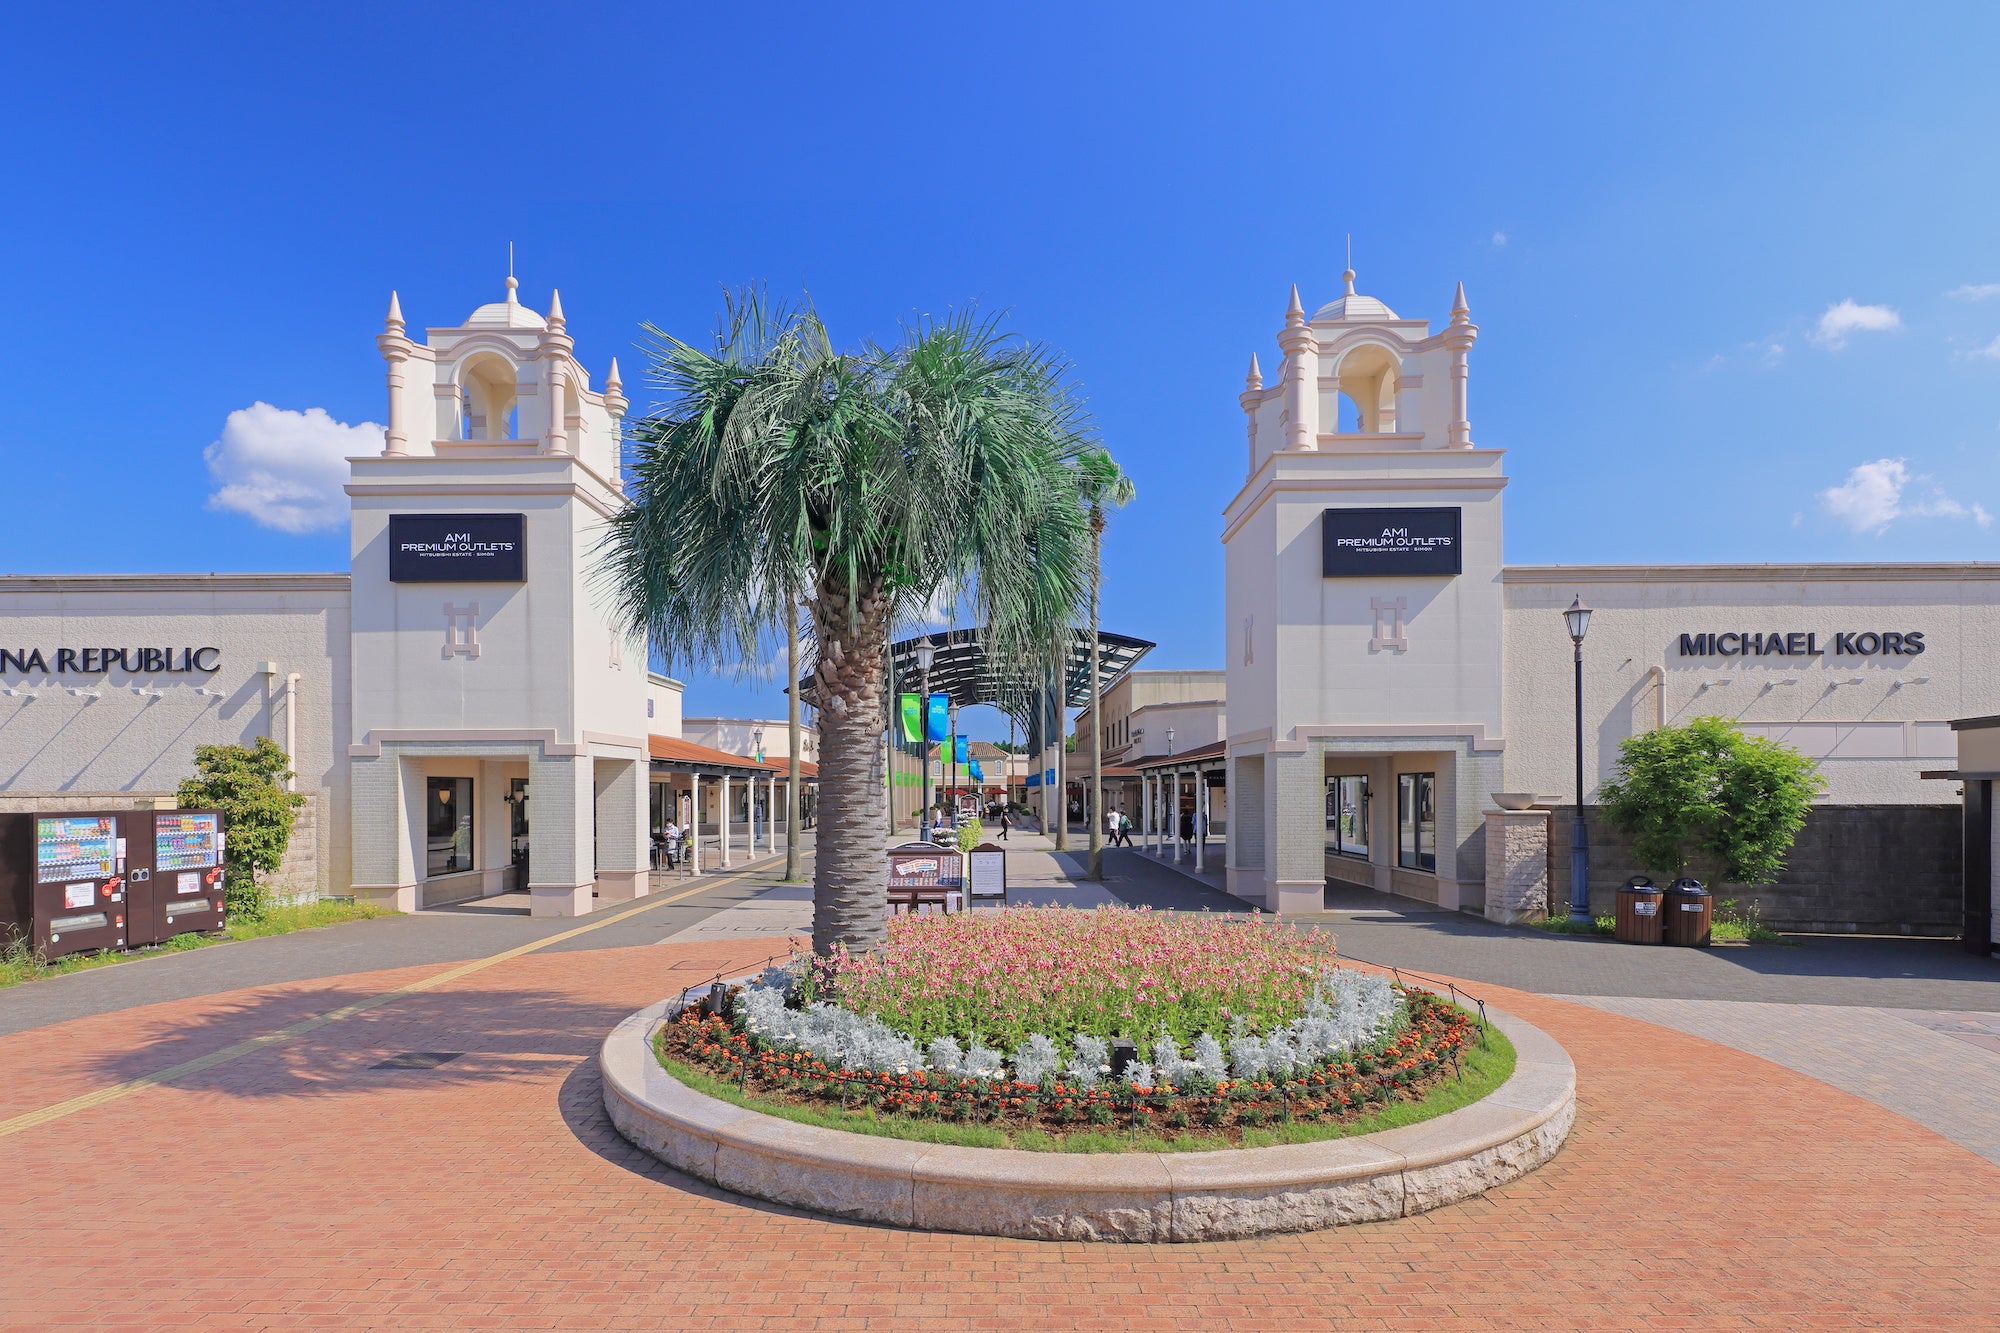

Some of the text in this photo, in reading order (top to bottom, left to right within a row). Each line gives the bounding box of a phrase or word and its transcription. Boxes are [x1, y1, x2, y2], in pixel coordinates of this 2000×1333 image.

[1381, 527, 1408, 537] AMI
[444, 533, 470, 543] AMI
[1337, 537, 1452, 547] PREMIUM OUTLETS
[401, 542, 513, 552] PREMIUM OUTLETS
[1680, 631, 1926, 656] MICHAEL KORS
[57, 646, 221, 673] REPUBLIC
